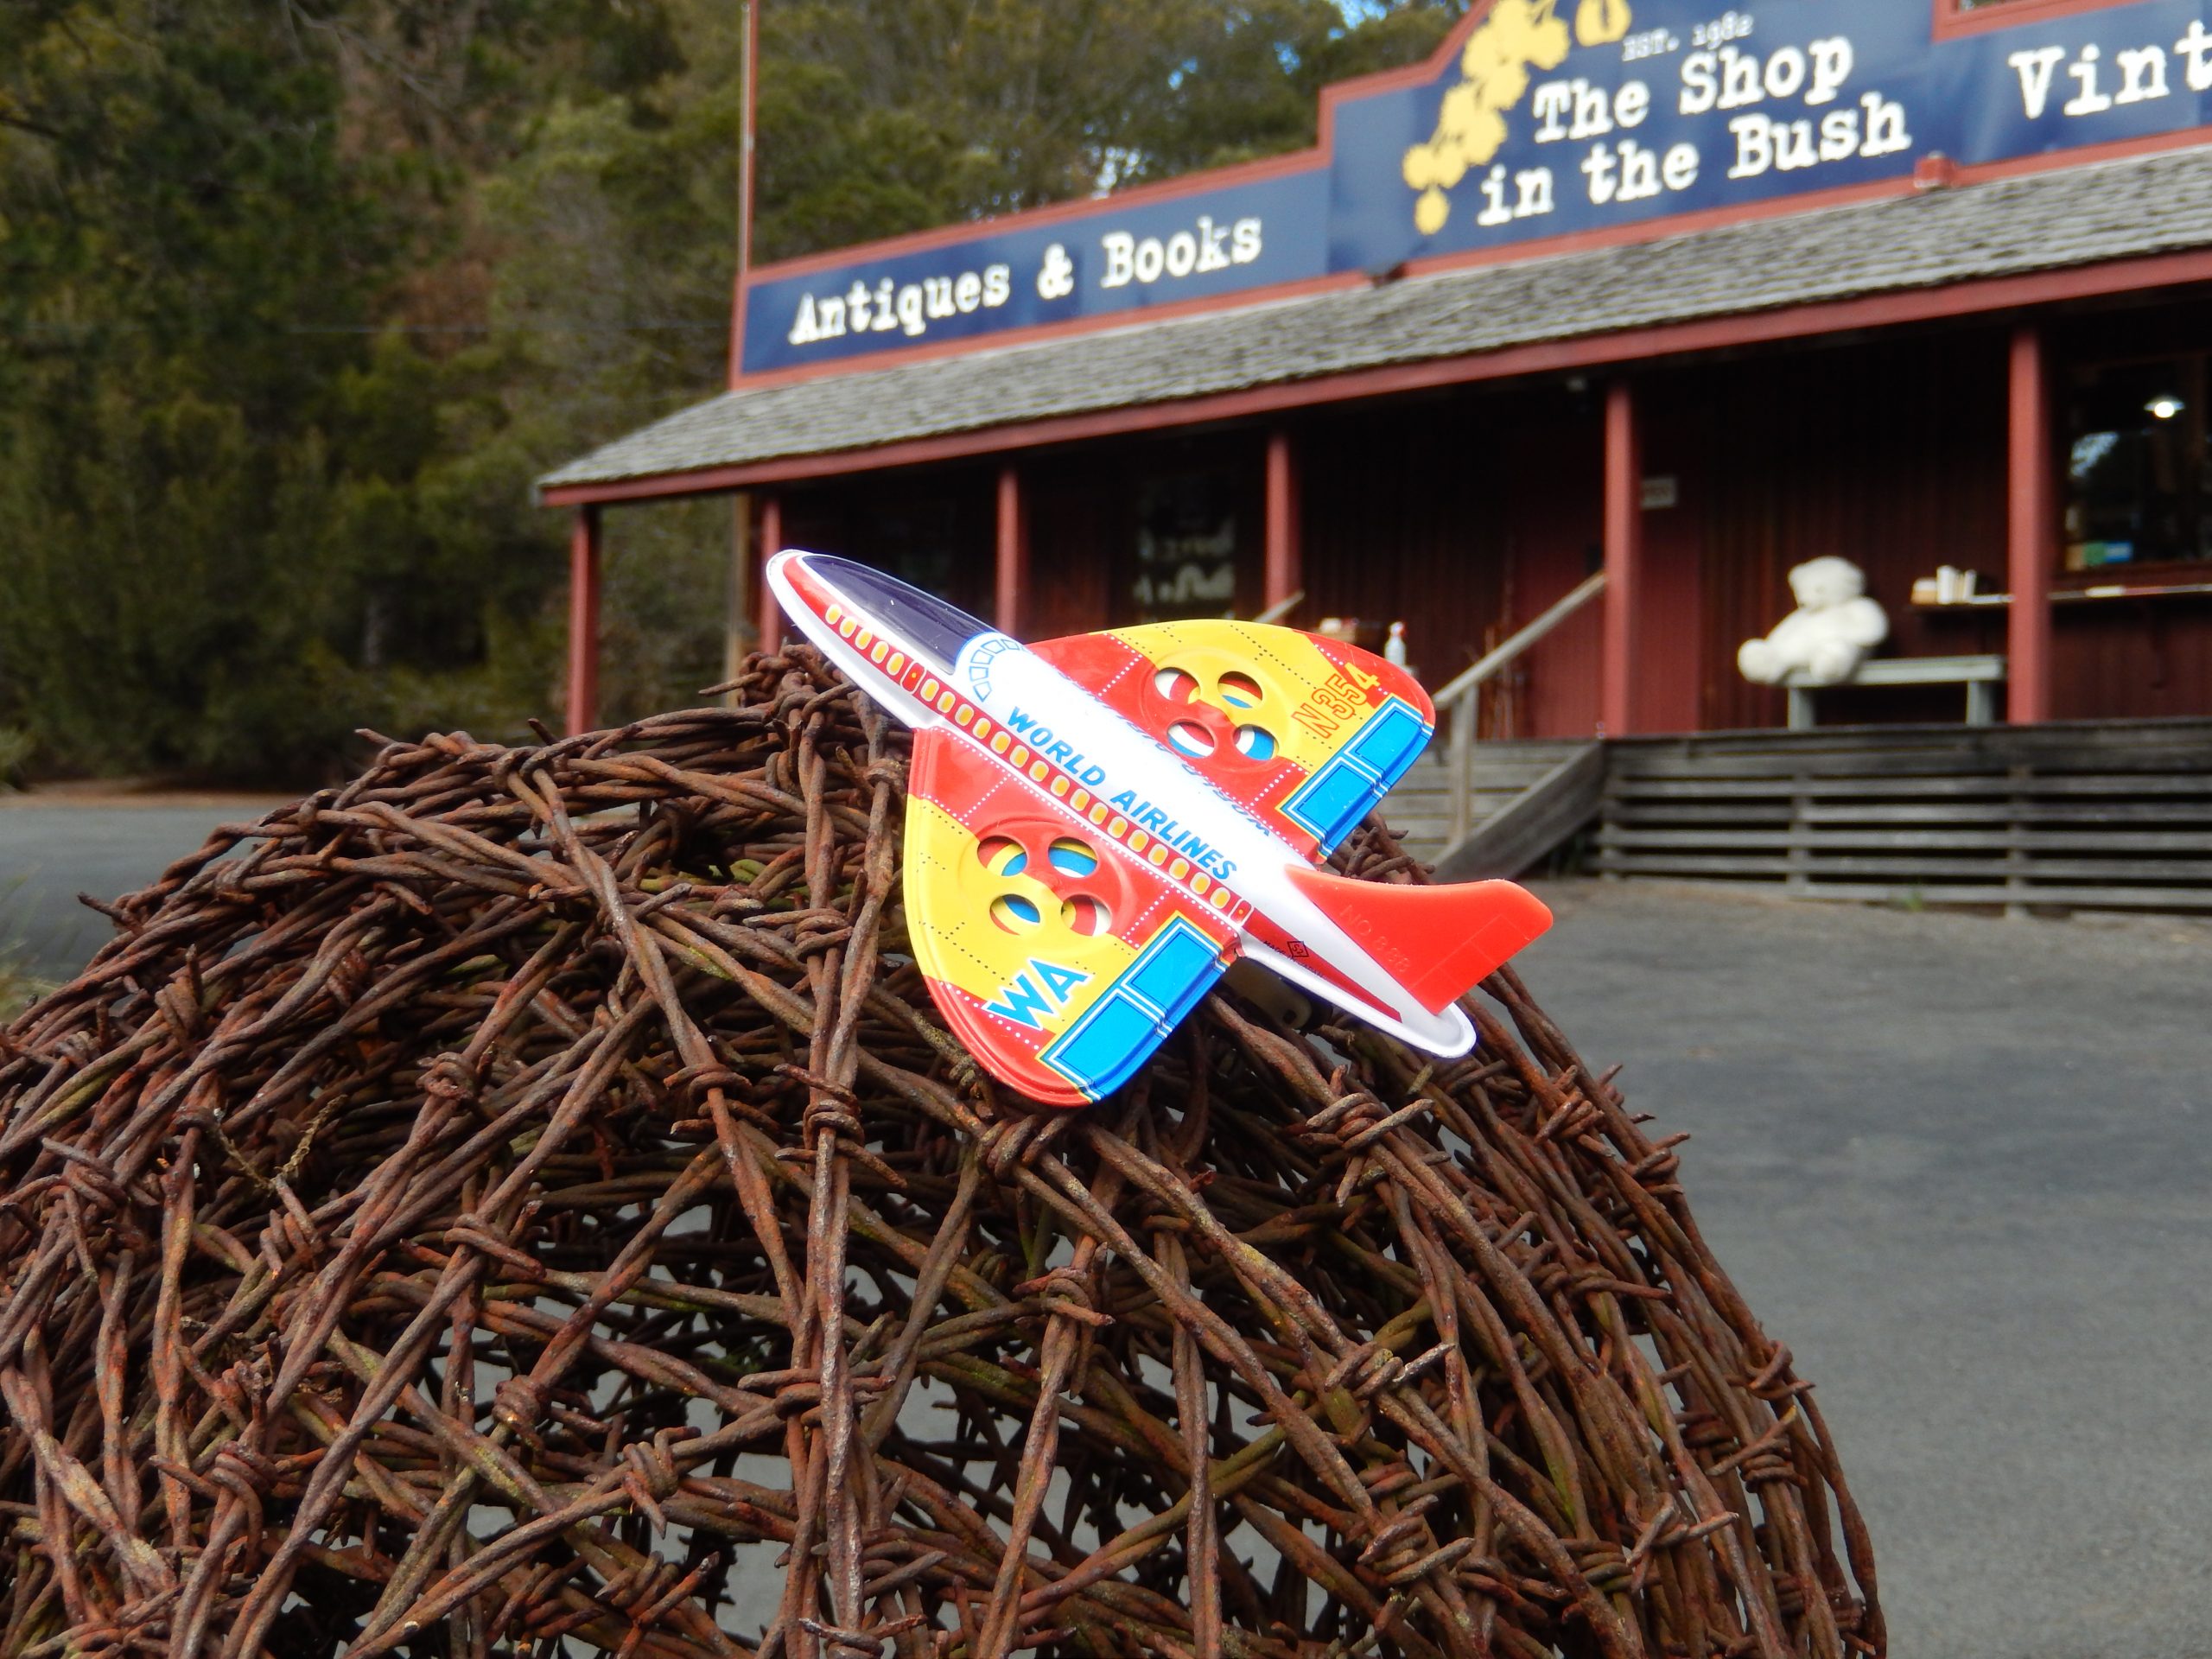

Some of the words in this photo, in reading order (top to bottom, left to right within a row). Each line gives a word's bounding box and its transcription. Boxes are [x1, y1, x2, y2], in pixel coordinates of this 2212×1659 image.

[1532, 78, 1649, 143] The
[1679, 36, 1853, 115] Shop
[2008, 19, 2212, 119] Vint
[1478, 164, 1554, 226] in
[1581, 137, 1699, 205] the
[1728, 92, 1911, 181] Bush
[790, 264, 1010, 345] Antiques
[1037, 243, 1075, 299] &
[1102, 217, 1262, 289] Books
[1291, 662, 1380, 739] N354
[1007, 706, 1105, 786] WORLD
[1109, 790, 1237, 880] AIRLINES
[983, 957, 1093, 1030] WA
